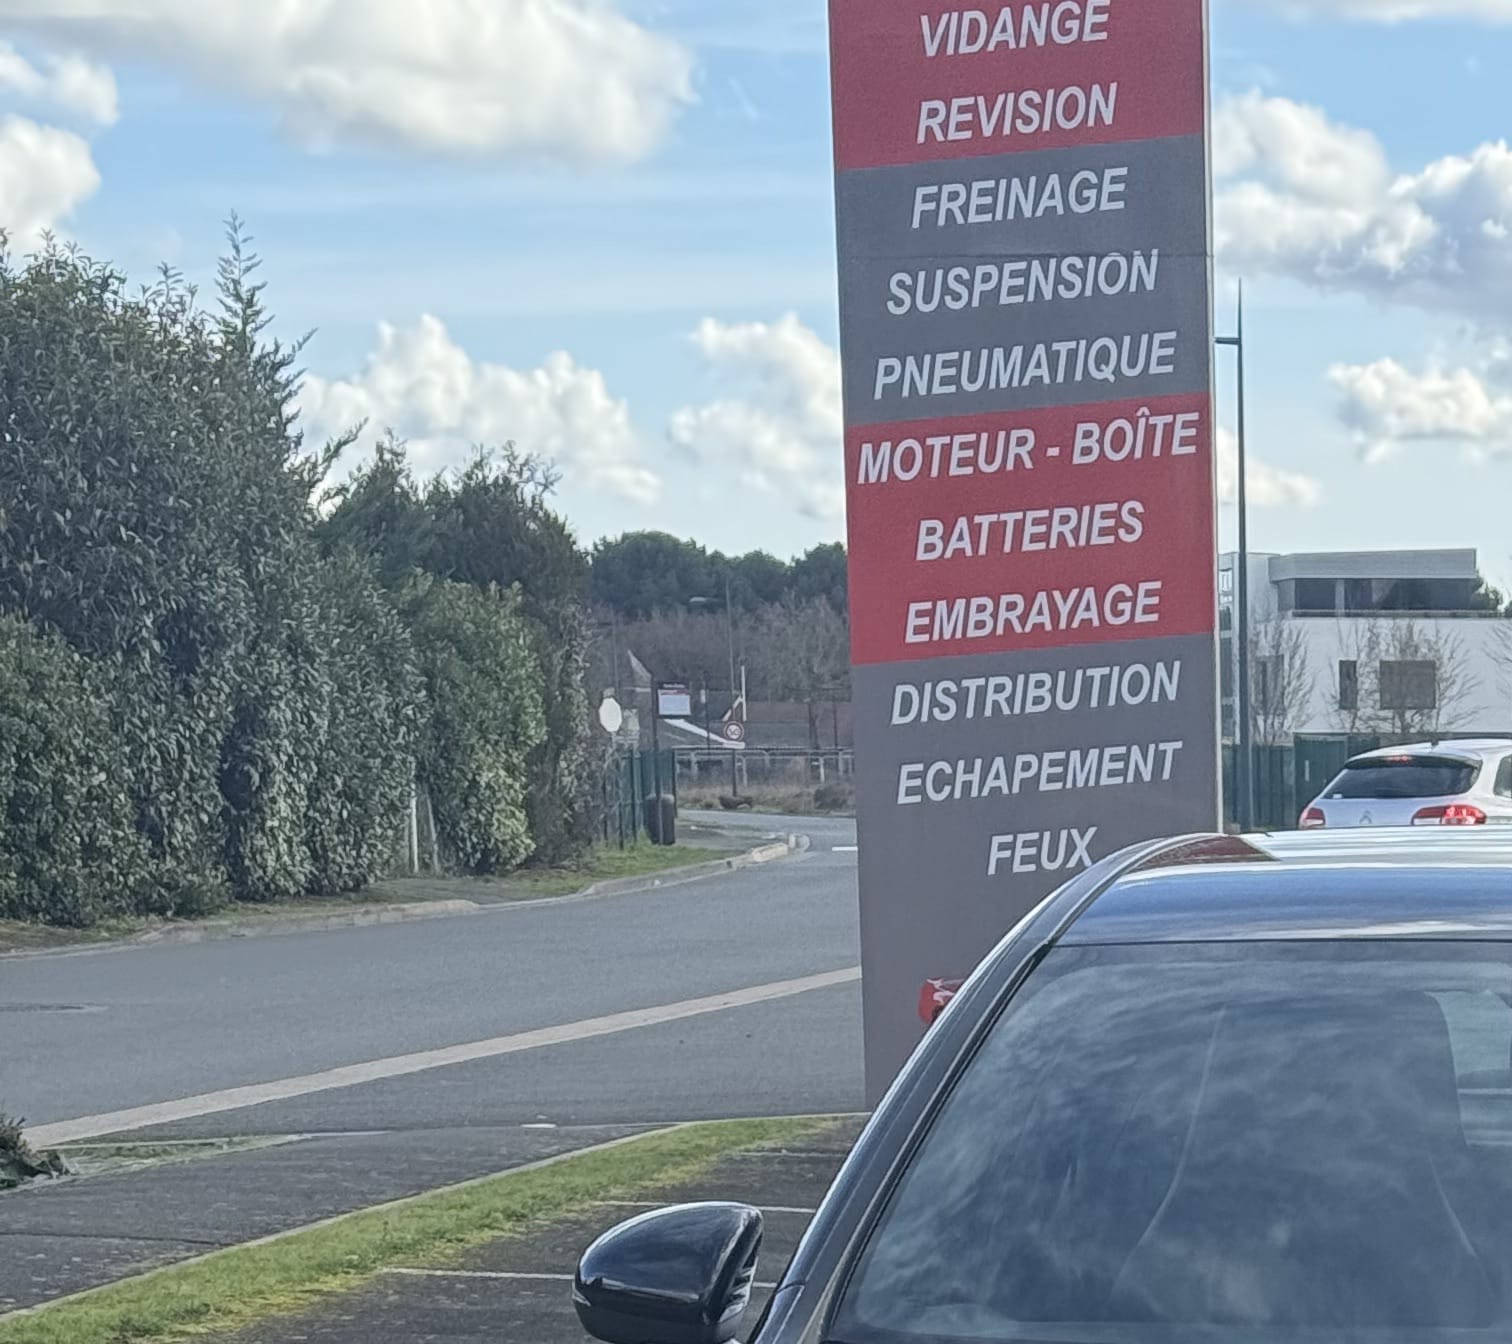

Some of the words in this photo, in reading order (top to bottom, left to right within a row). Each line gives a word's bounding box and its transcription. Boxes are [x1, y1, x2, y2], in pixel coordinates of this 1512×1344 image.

[920, 0, 1110, 57] VIDANGE
[917, 82, 1118, 143] REVISION
[912, 167, 1128, 229] FREINAGE
[886, 249, 1159, 315] SUSPENSION
[873, 331, 1177, 400] PNEUMATIQUE
[858, 428, 1036, 484] MOTEUR
[1072, 406, 1200, 465] BOÎTE
[916, 501, 1145, 561] BATTERIES
[905, 581, 1162, 643] EMBRAYAGE
[891, 661, 1181, 725] DISTRIBUTION
[897, 741, 1183, 804] ECHAPEMENT
[987, 826, 1098, 875] FEUX
